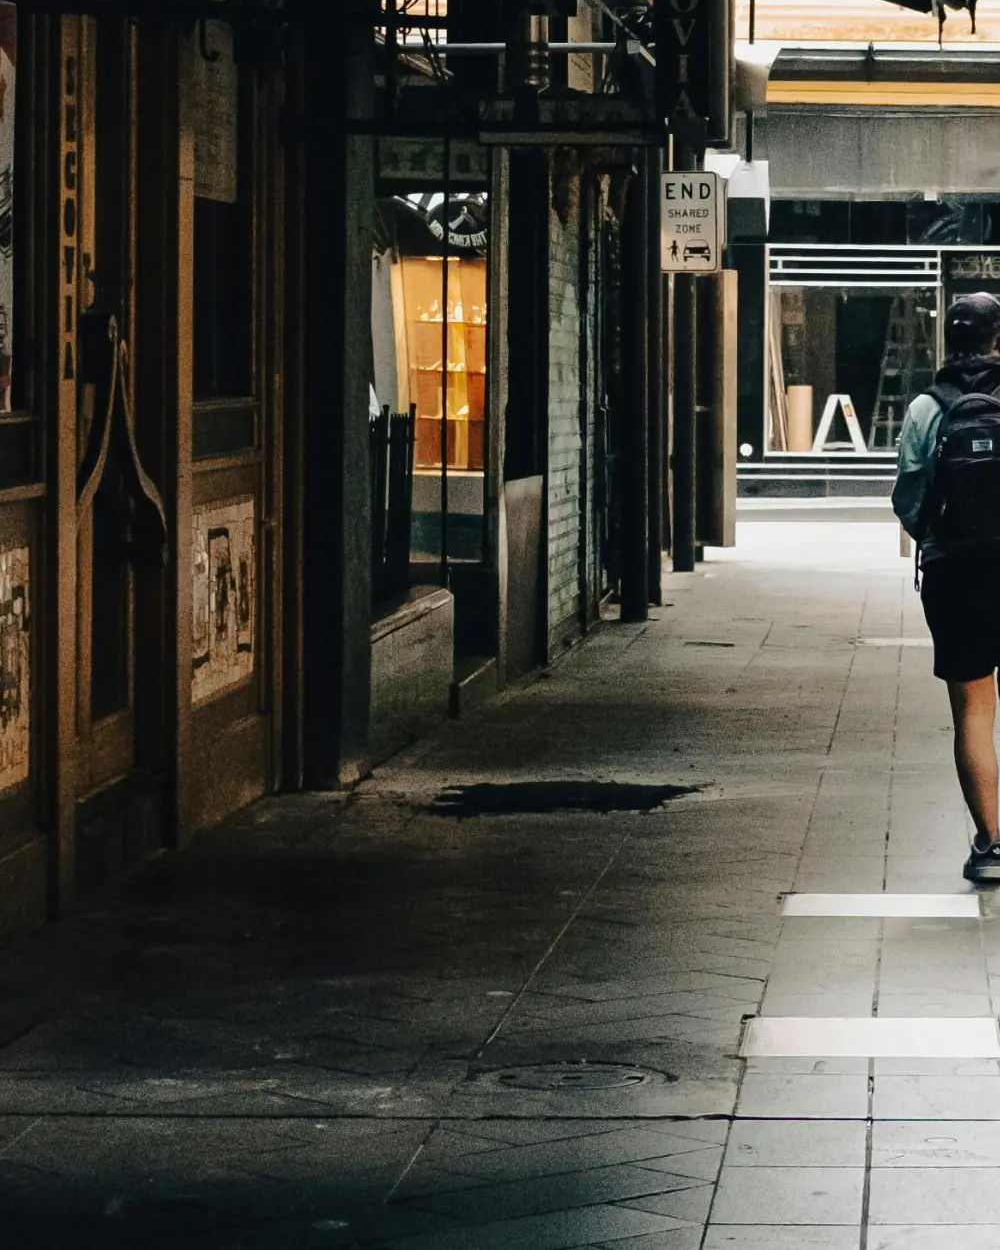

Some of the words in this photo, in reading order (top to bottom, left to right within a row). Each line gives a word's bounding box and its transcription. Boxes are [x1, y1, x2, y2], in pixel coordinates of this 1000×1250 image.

[666, 182, 711, 199] END
[667, 208, 709, 219] SHARED
[676, 223, 703, 233] ZONE
